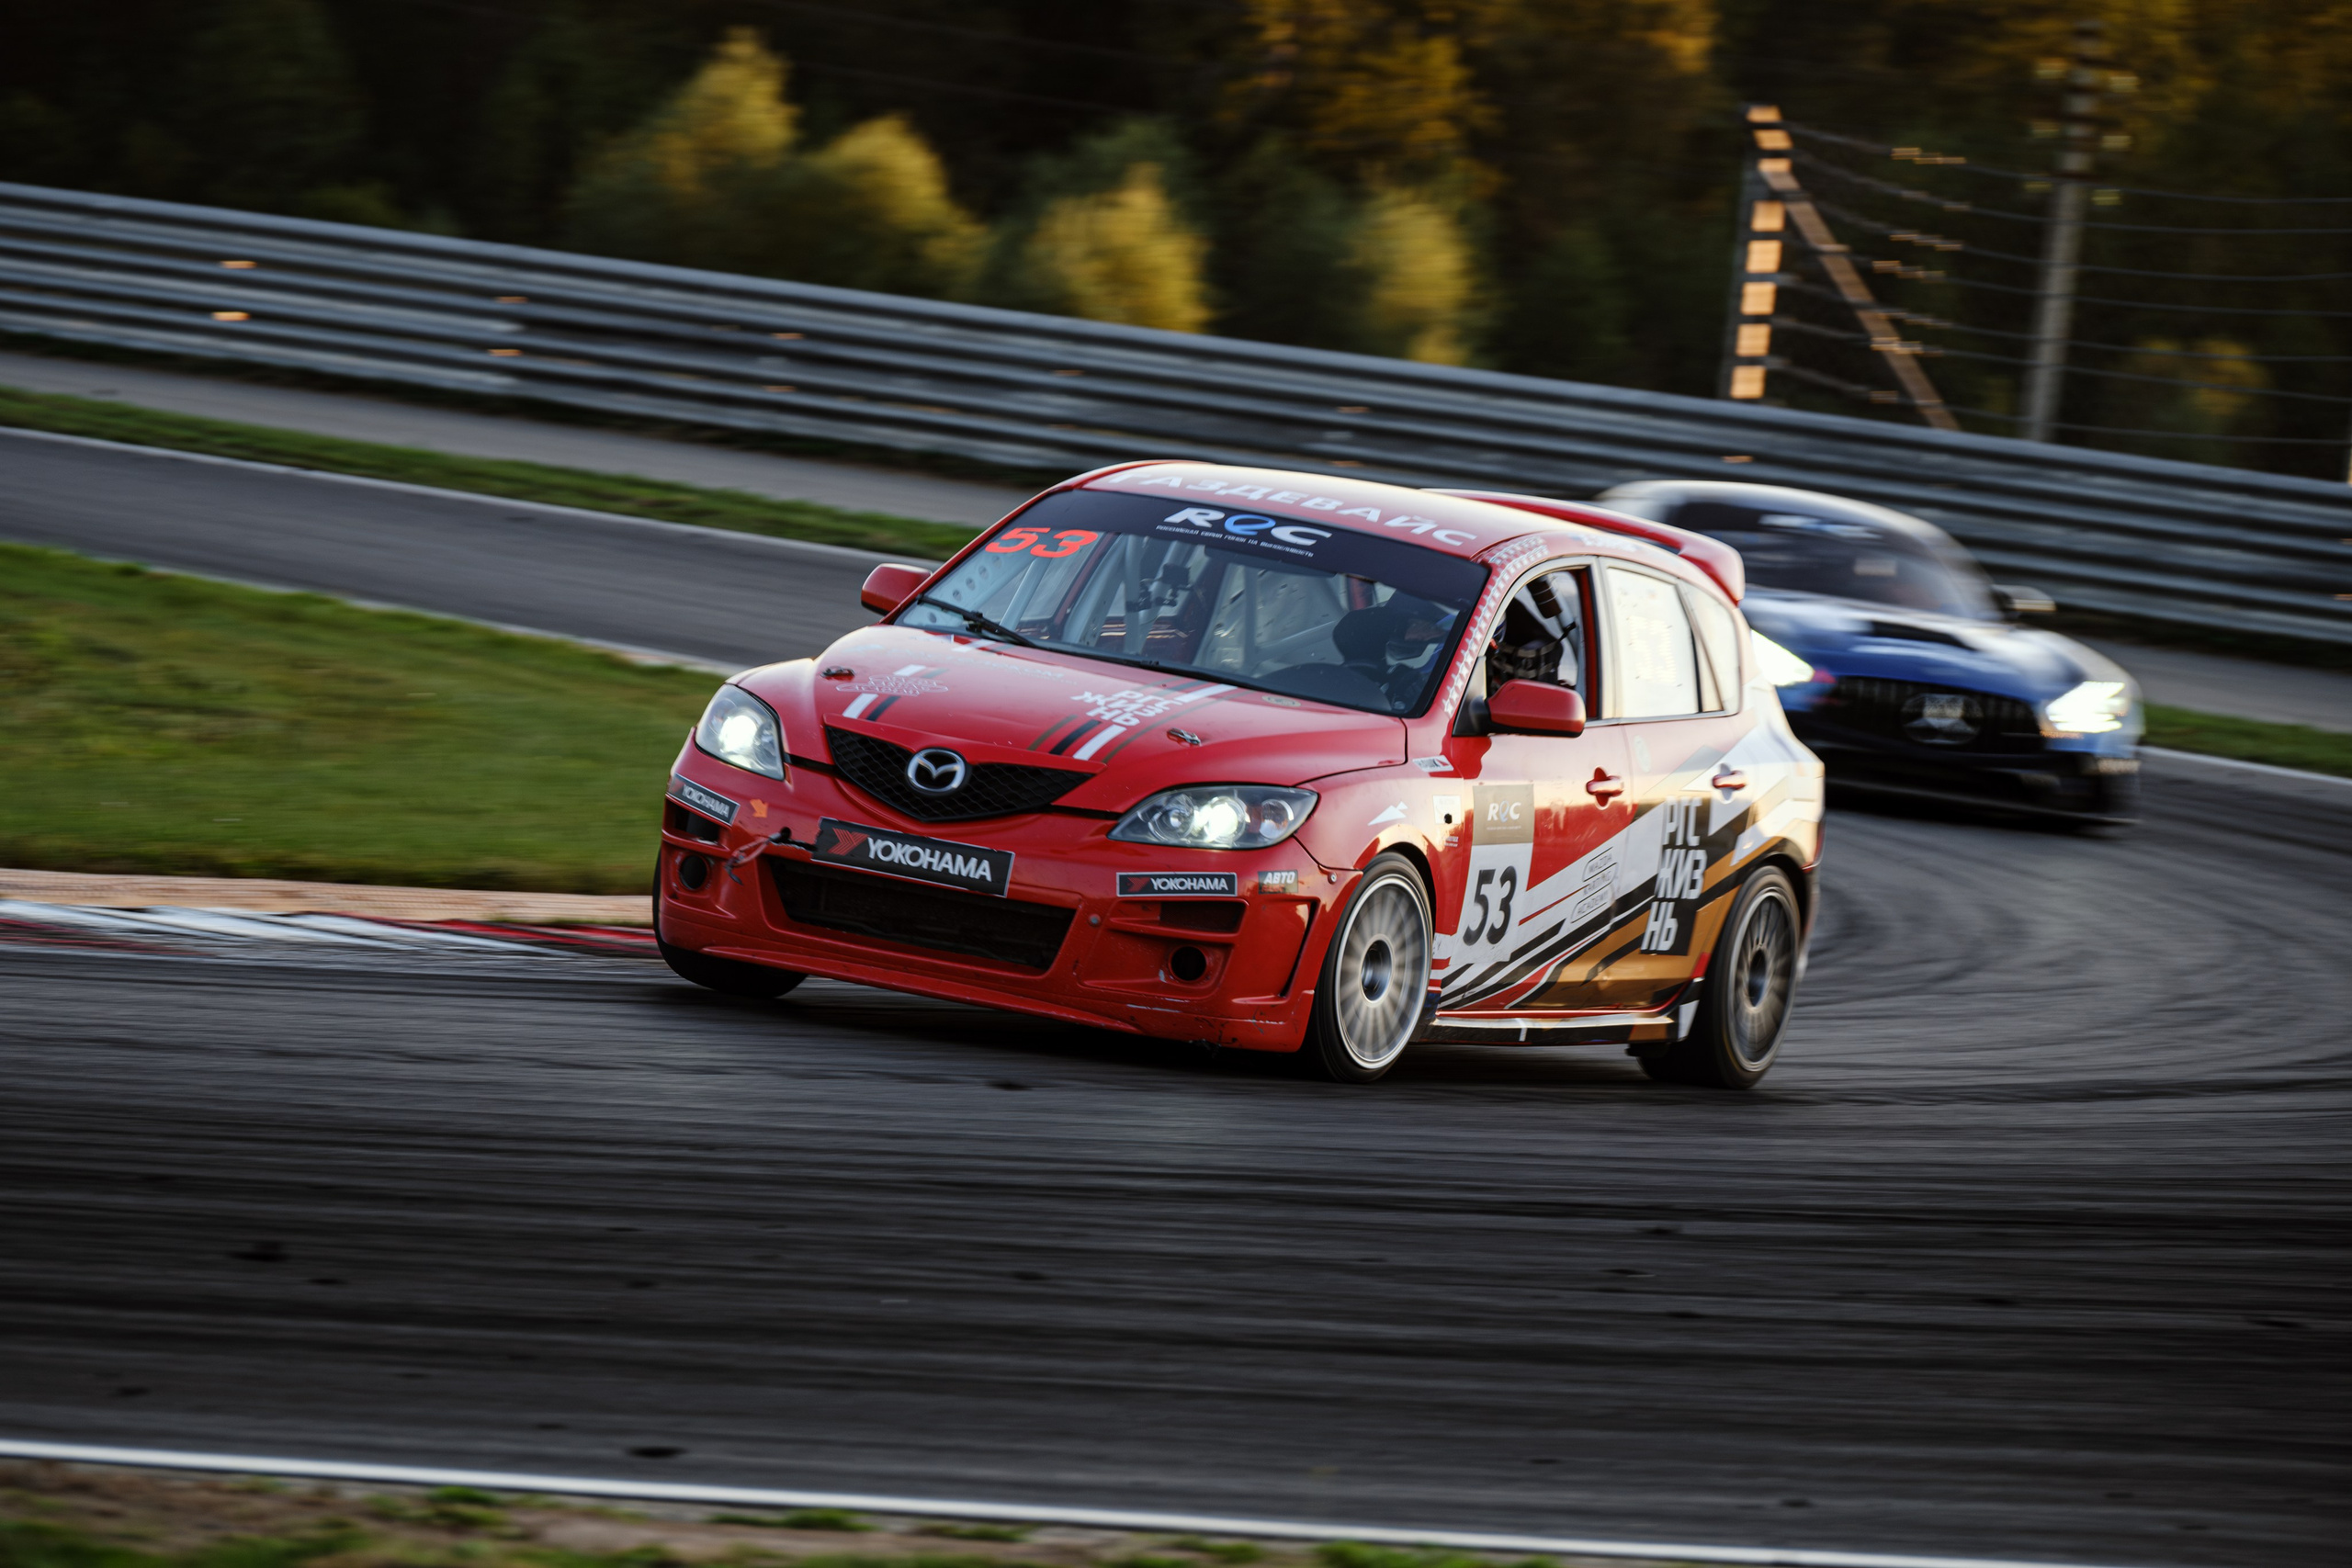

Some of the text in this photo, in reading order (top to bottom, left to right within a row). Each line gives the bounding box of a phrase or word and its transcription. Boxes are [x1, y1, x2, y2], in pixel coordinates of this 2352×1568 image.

[1108, 473, 1477, 547] ГАЗДЕВАЙС
[985, 527, 1098, 558] 53
[1630, 615, 1677, 683] 53
[1104, 690, 1183, 711] РГС
[682, 784, 730, 818] YOKOHAMA
[1663, 795, 1702, 846] РГС
[867, 836, 992, 882] YOKOHAMA
[1263, 872, 1295, 885] АВТО
[1150, 877, 1228, 891] YOKOHAMA
[1463, 865, 1517, 946] 53
[1641, 901, 1679, 952] НЬ
